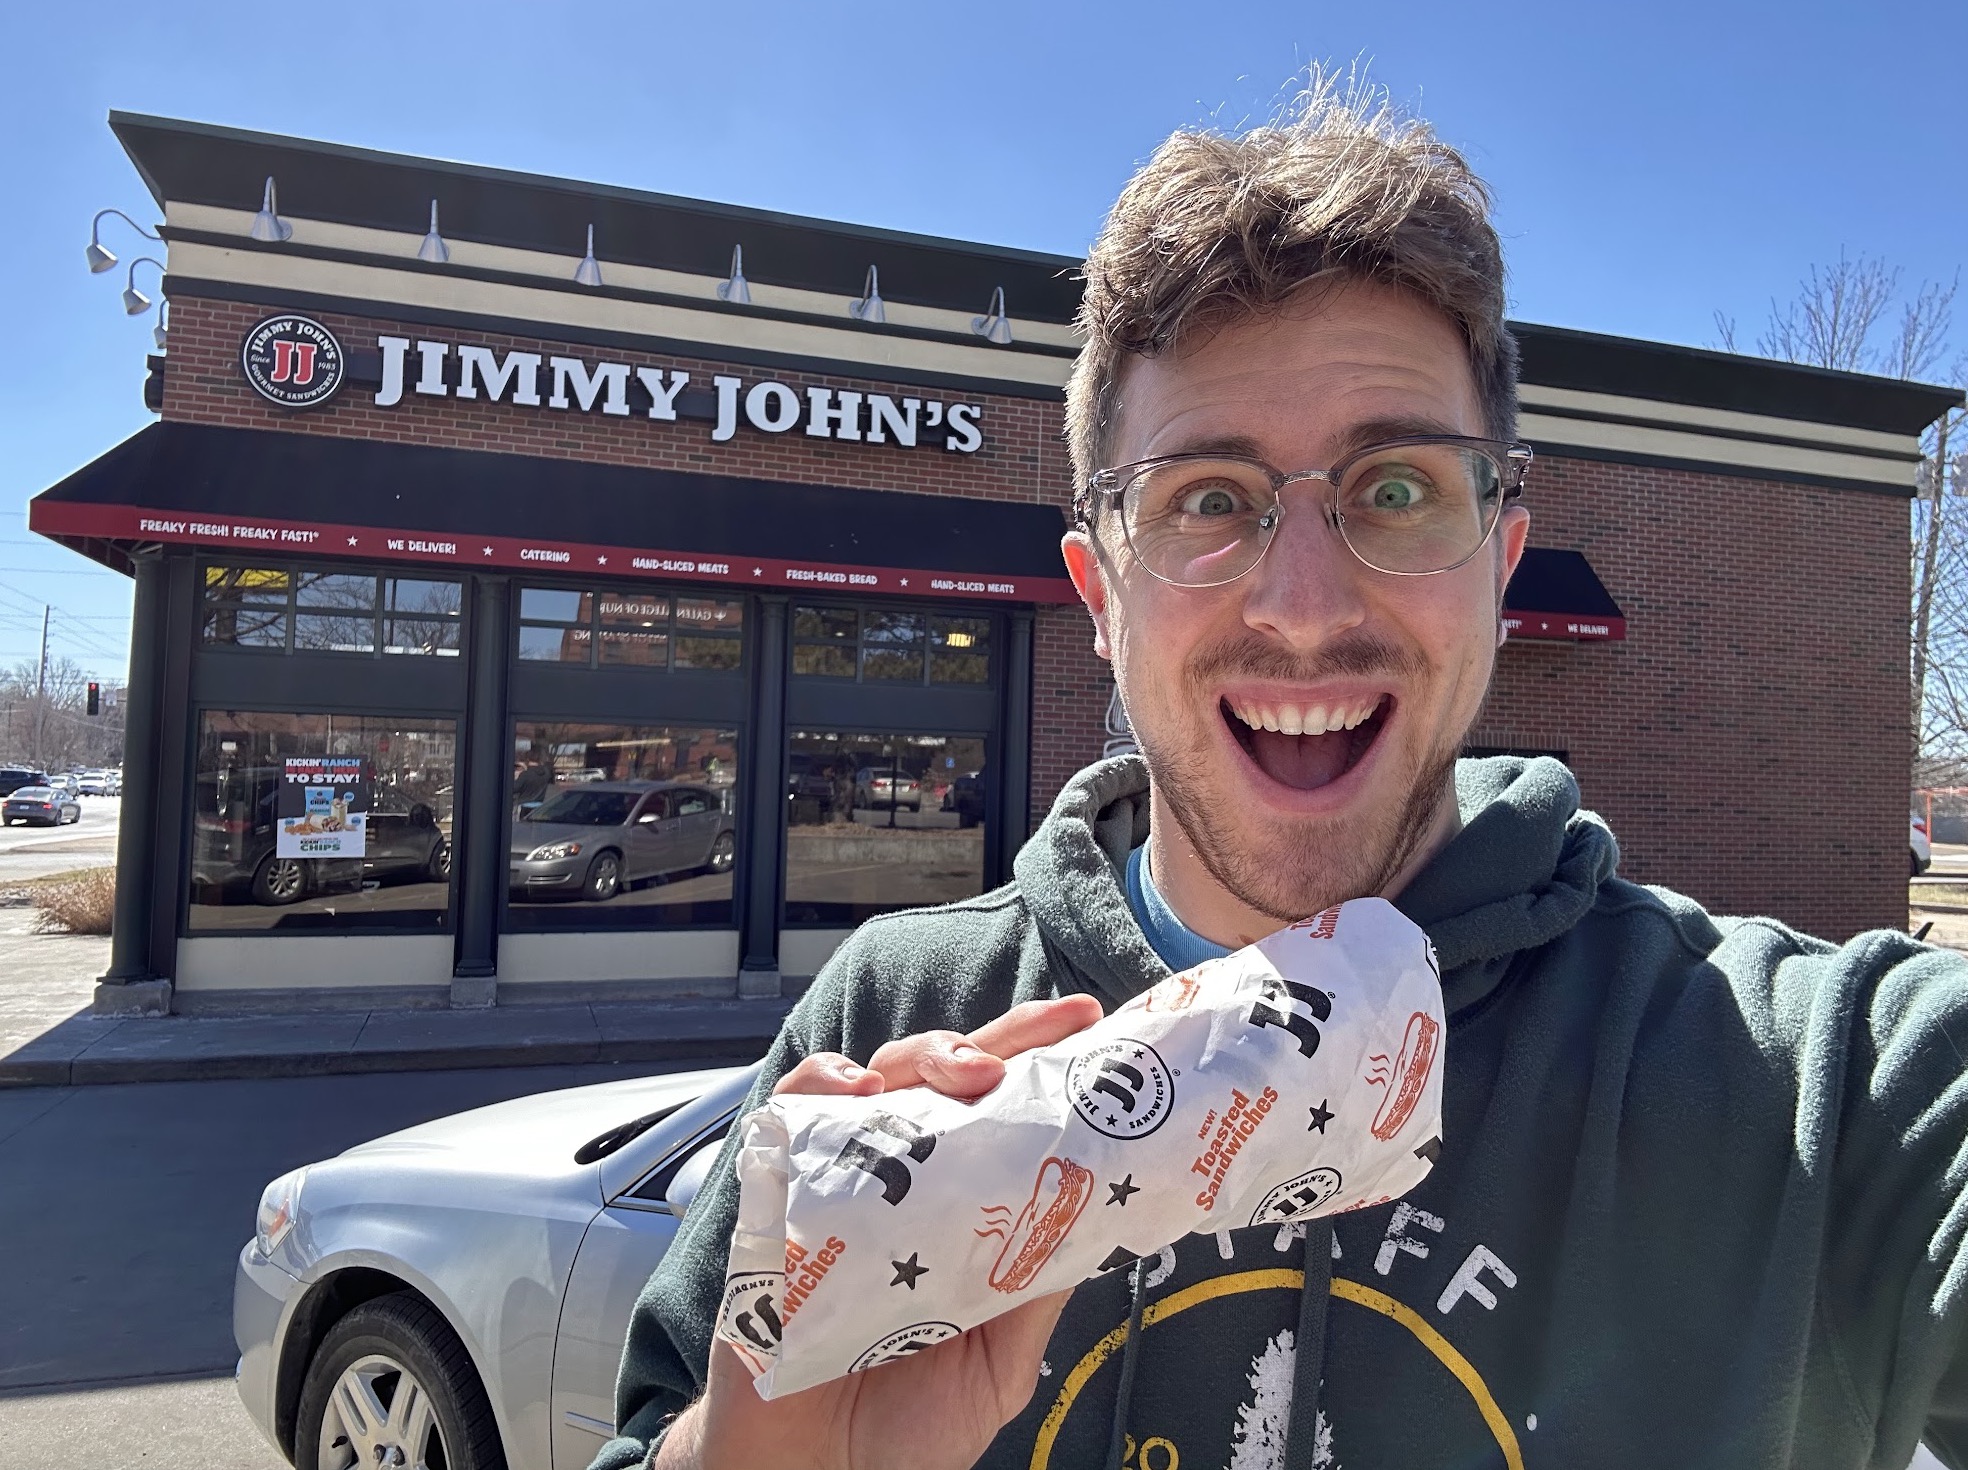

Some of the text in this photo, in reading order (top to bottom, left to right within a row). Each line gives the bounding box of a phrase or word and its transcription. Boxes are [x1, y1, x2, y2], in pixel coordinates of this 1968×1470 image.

[252, 321, 336, 360] JIMMY JOHN'S
[271, 339, 317, 385] JJ
[252, 364, 335, 400] GOURMET SANDWICHES
[374, 335, 983, 453] JIMMY JOHN'S
[140, 518, 186, 534] FREAKY
[189, 522, 229, 537] FRESH!
[233, 525, 278, 541] FREAKY
[387, 538, 457, 555] WE DELIVER!
[520, 548, 570, 563] CATERING
[632, 557, 729, 575] HAND-SLICED MEATS
[786, 568, 878, 585] FRESH-BAKED BREAD
[931, 578, 1014, 594] HAND-SLICED MEATS
[1567, 622, 1578, 634] WE
[322, 758, 360, 767] RANCH
[285, 773, 360, 784] TO STAY!
[1092, 1058, 1144, 1114] JJ
[1128, 1066, 1164, 1129] SANDWICHES
[1191, 1087, 1250, 1178] Toasted
[1198, 1108, 1218, 1140] NEW!
[1195, 1085, 1278, 1211] Sandwiches
[782, 1235, 846, 1320] wiches
[880, 1327, 934, 1351] JOHN'S
